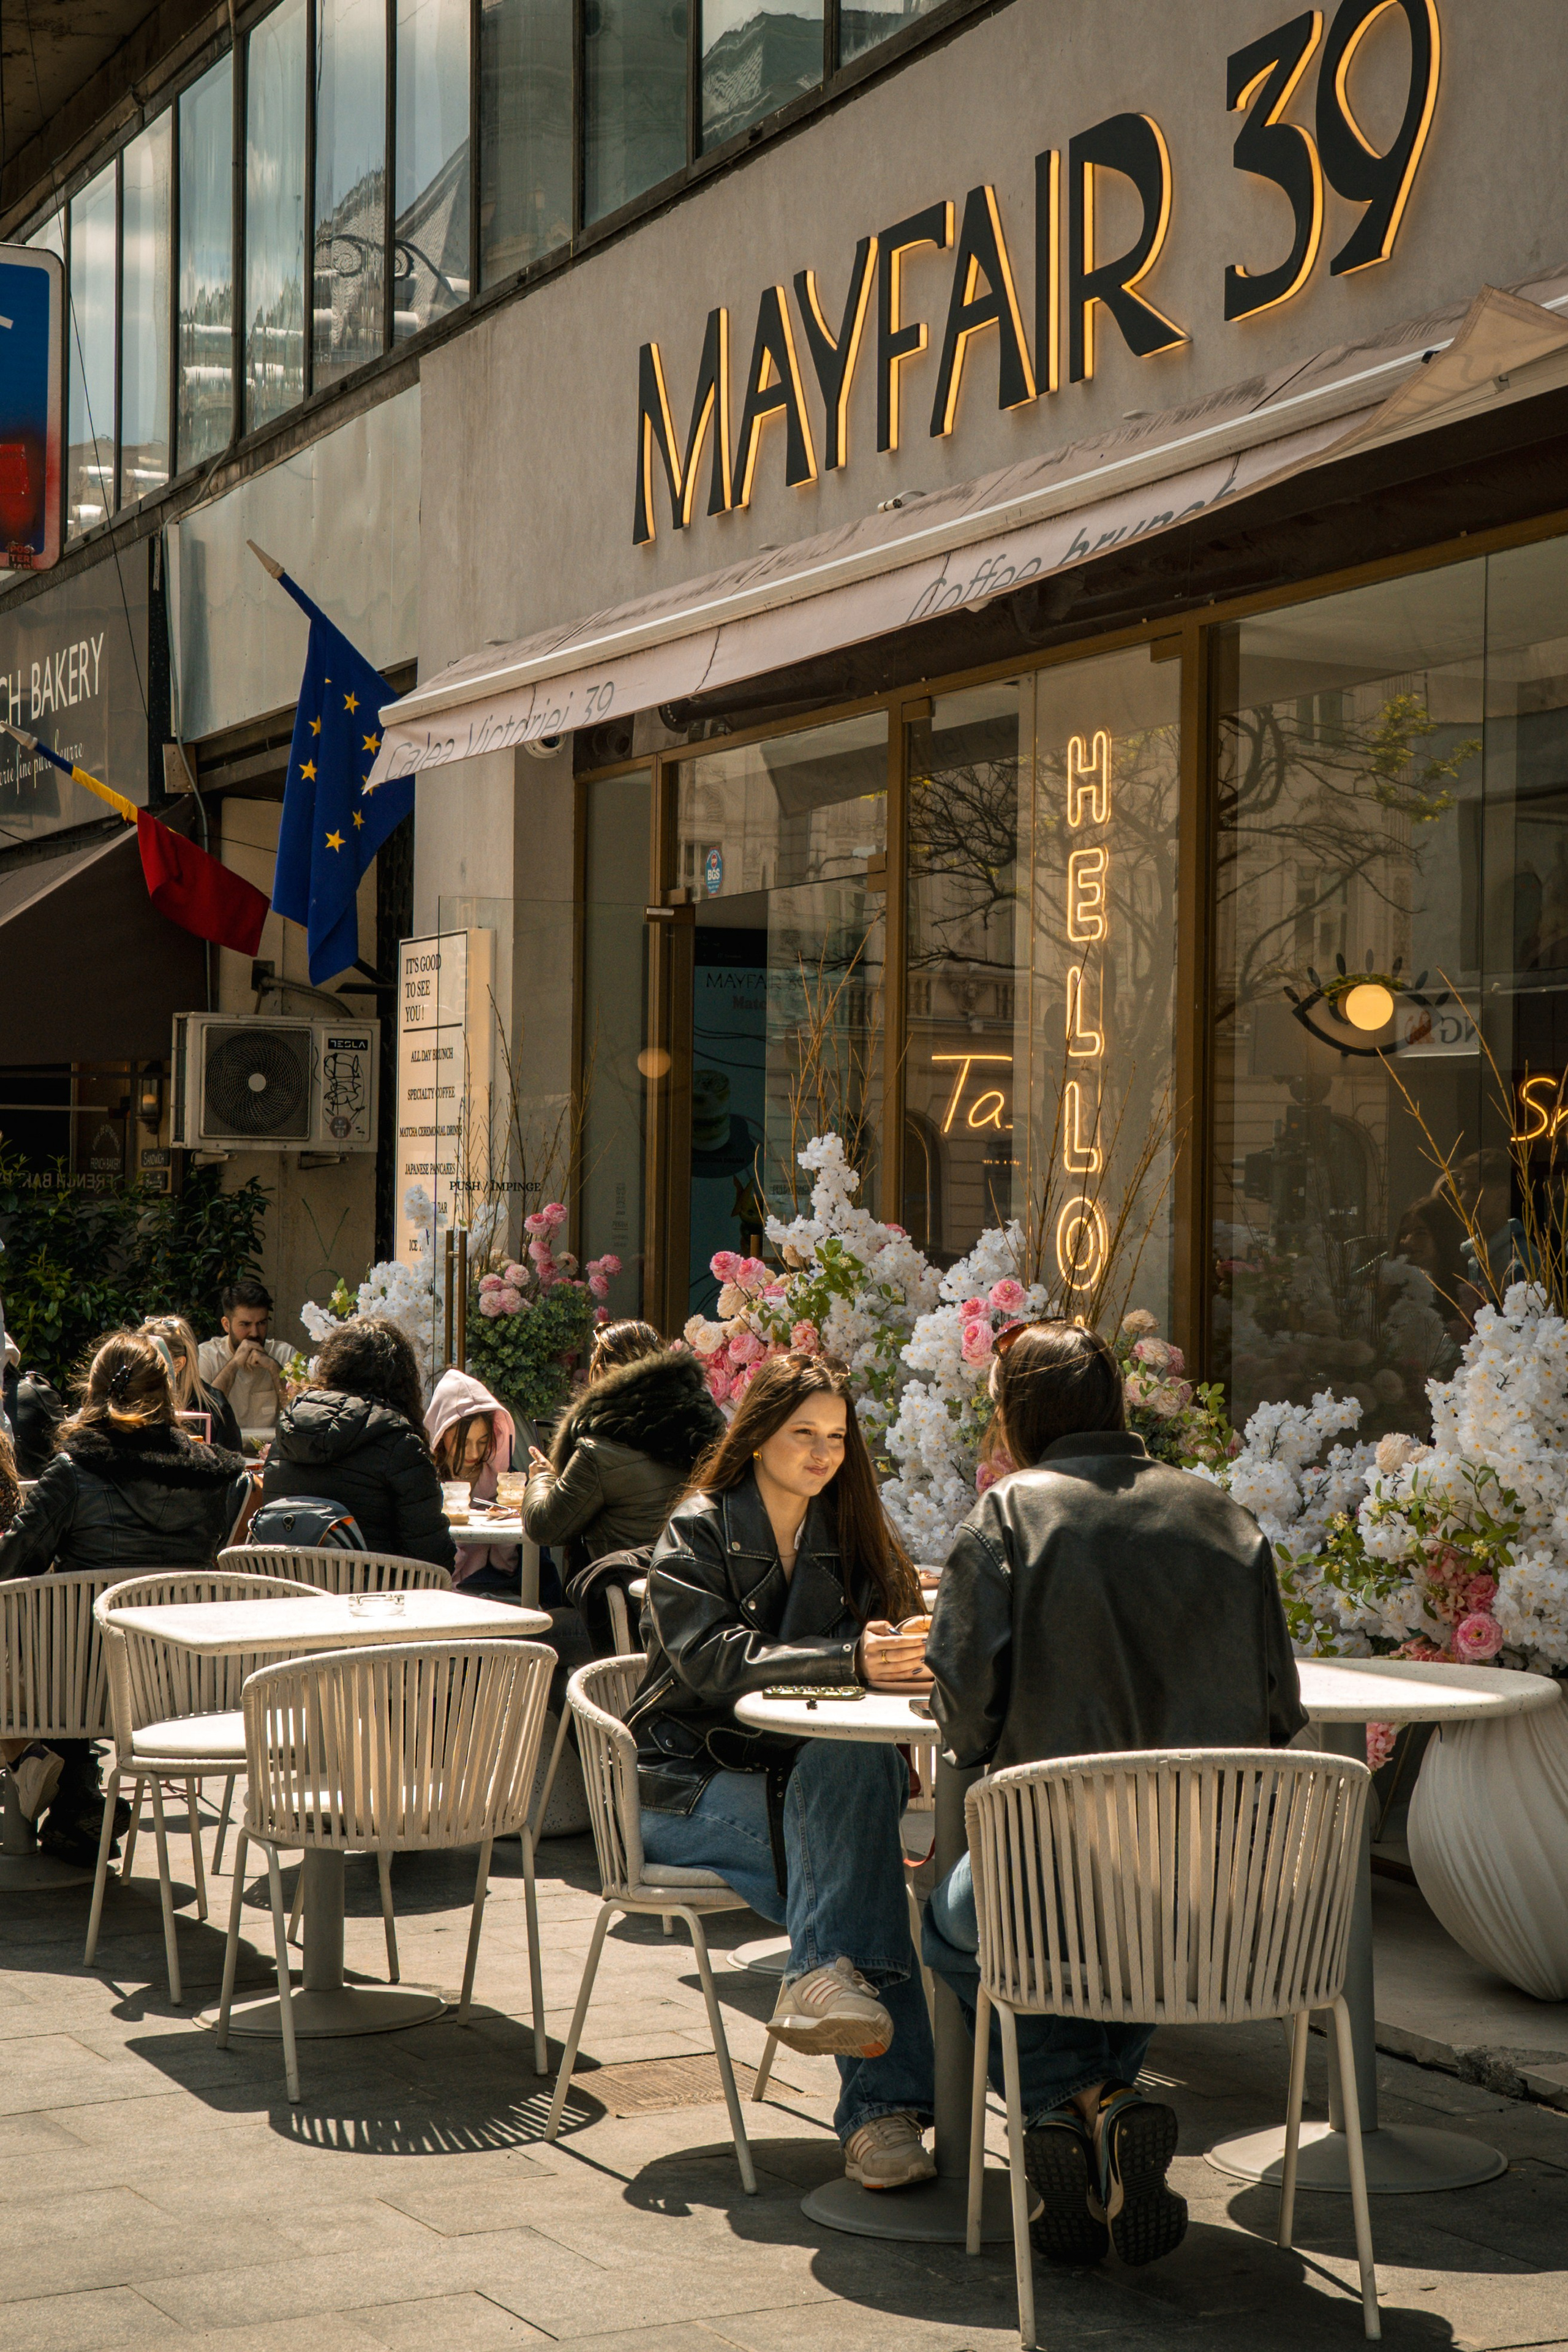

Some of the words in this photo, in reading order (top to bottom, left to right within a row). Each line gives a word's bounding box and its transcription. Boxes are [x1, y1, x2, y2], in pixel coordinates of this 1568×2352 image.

[632, 112, 1191, 546] MAYFAIR
[1224, 0, 1441, 322] 39
[905, 553, 1042, 624] Coffee
[31, 632, 104, 720] BAKERY
[384, 731, 455, 780] Calea
[581, 680, 615, 726] 39
[707, 868, 720, 881] BGS
[405, 957, 420, 974] IT'S
[420, 953, 442, 972] GOOD
[405, 981, 416, 998] TO
[417, 979, 431, 997] SEE
[706, 973, 781, 990] MAYFAR
[1055, 729, 1109, 1291] HELLO
[330, 1039, 366, 1049] TESLA
[411, 1050, 421, 1063] ALL
[421, 1049, 432, 1061] DAY
[432, 1047, 453, 1061] BRUNCH
[407, 1088, 435, 1101] SPECIALTY
[435, 1086, 456, 1099] COFFEE
[399, 1127, 418, 1137] MATCHA
[405, 1163, 429, 1175] JAPANESE
[429, 1163, 456, 1175] PANCAKES
[449, 1181, 481, 1191] PUSH
[409, 1239, 418, 1251] ICE
